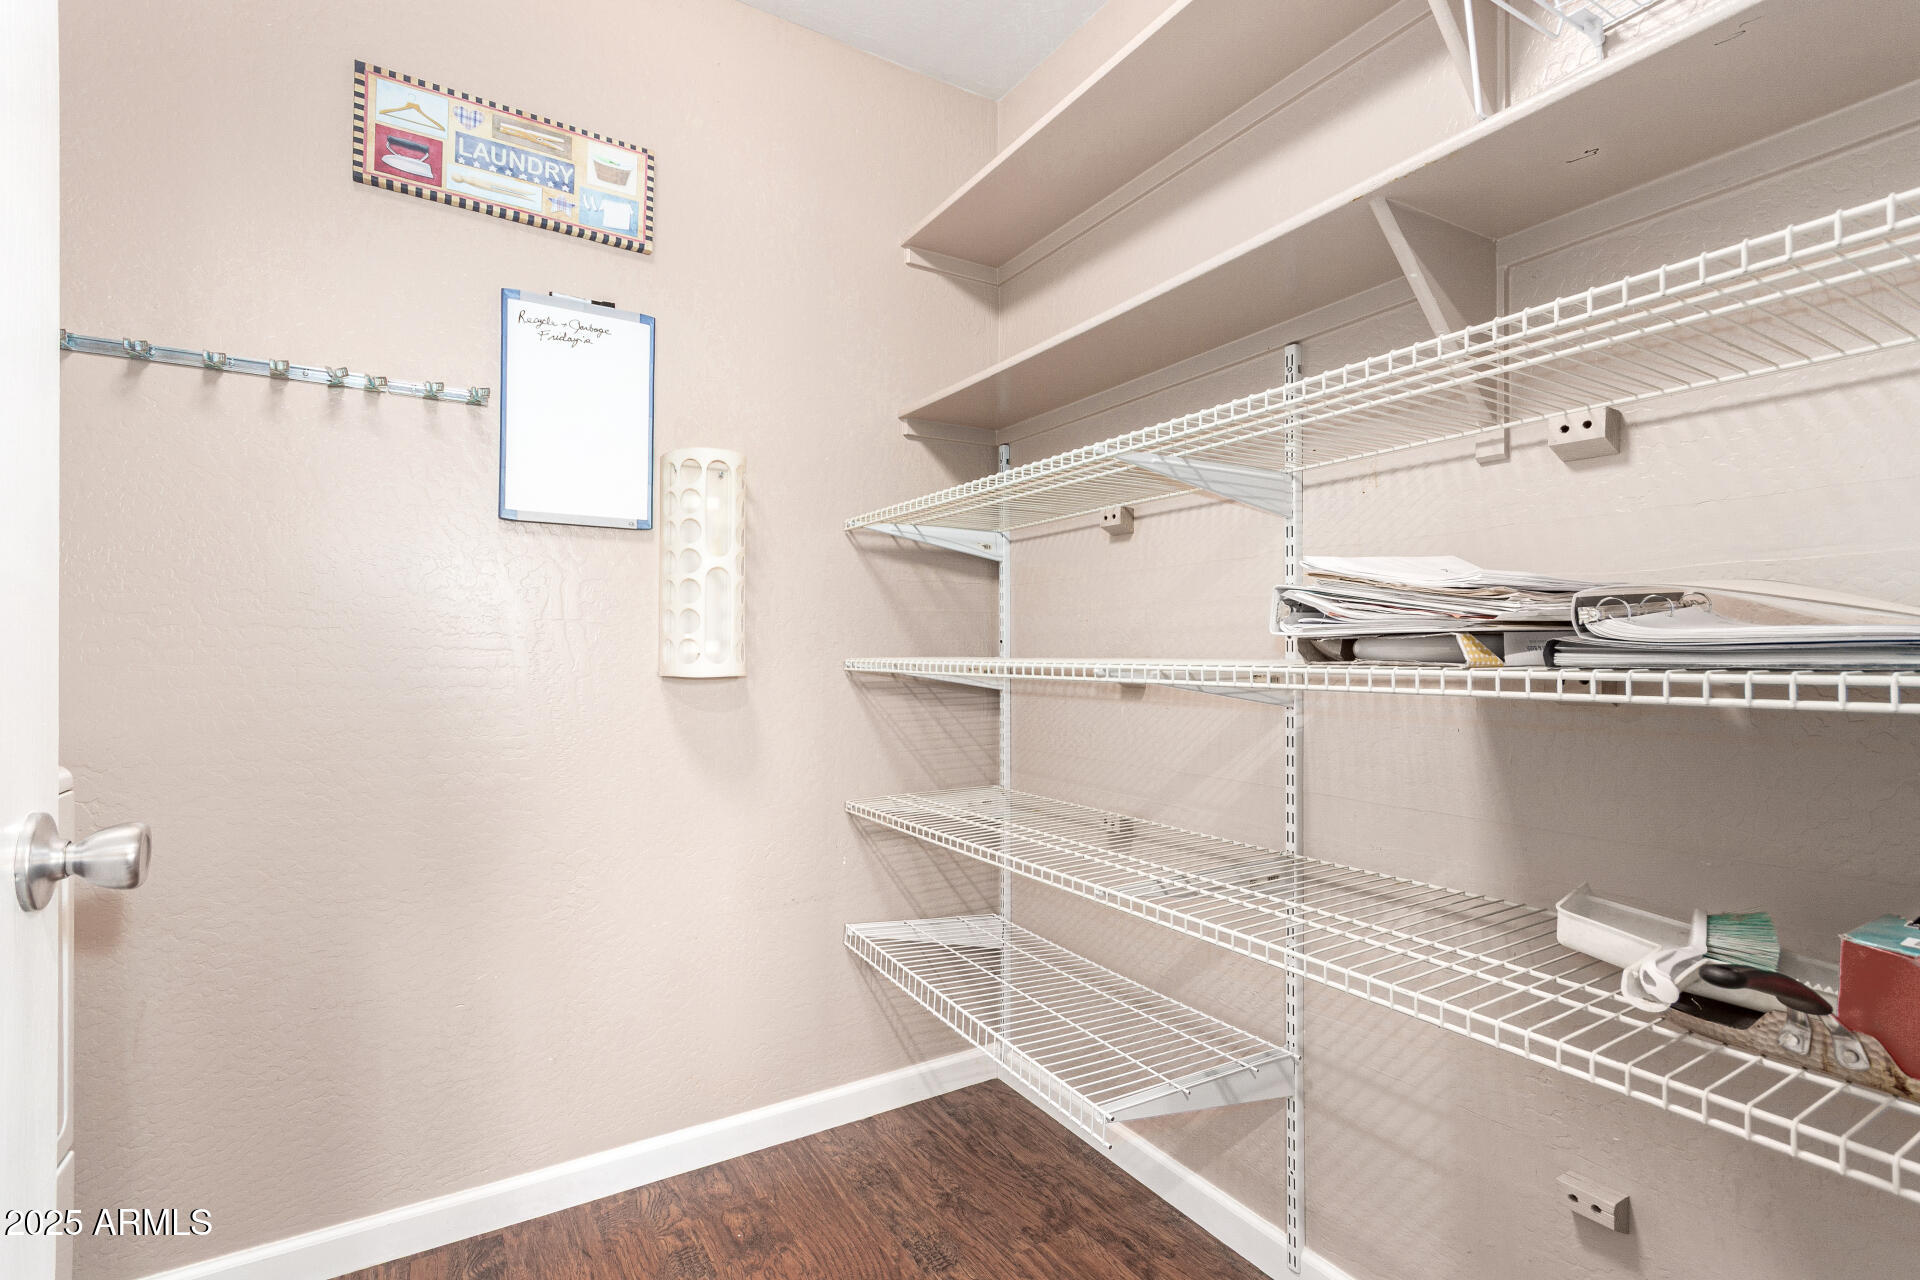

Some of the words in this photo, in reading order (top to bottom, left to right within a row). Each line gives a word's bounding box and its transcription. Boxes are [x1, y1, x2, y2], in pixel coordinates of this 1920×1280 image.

[458, 137, 574, 184] LAUNDRY
[518, 309, 558, 329] Recycle
[569, 319, 612, 338] Garbage
